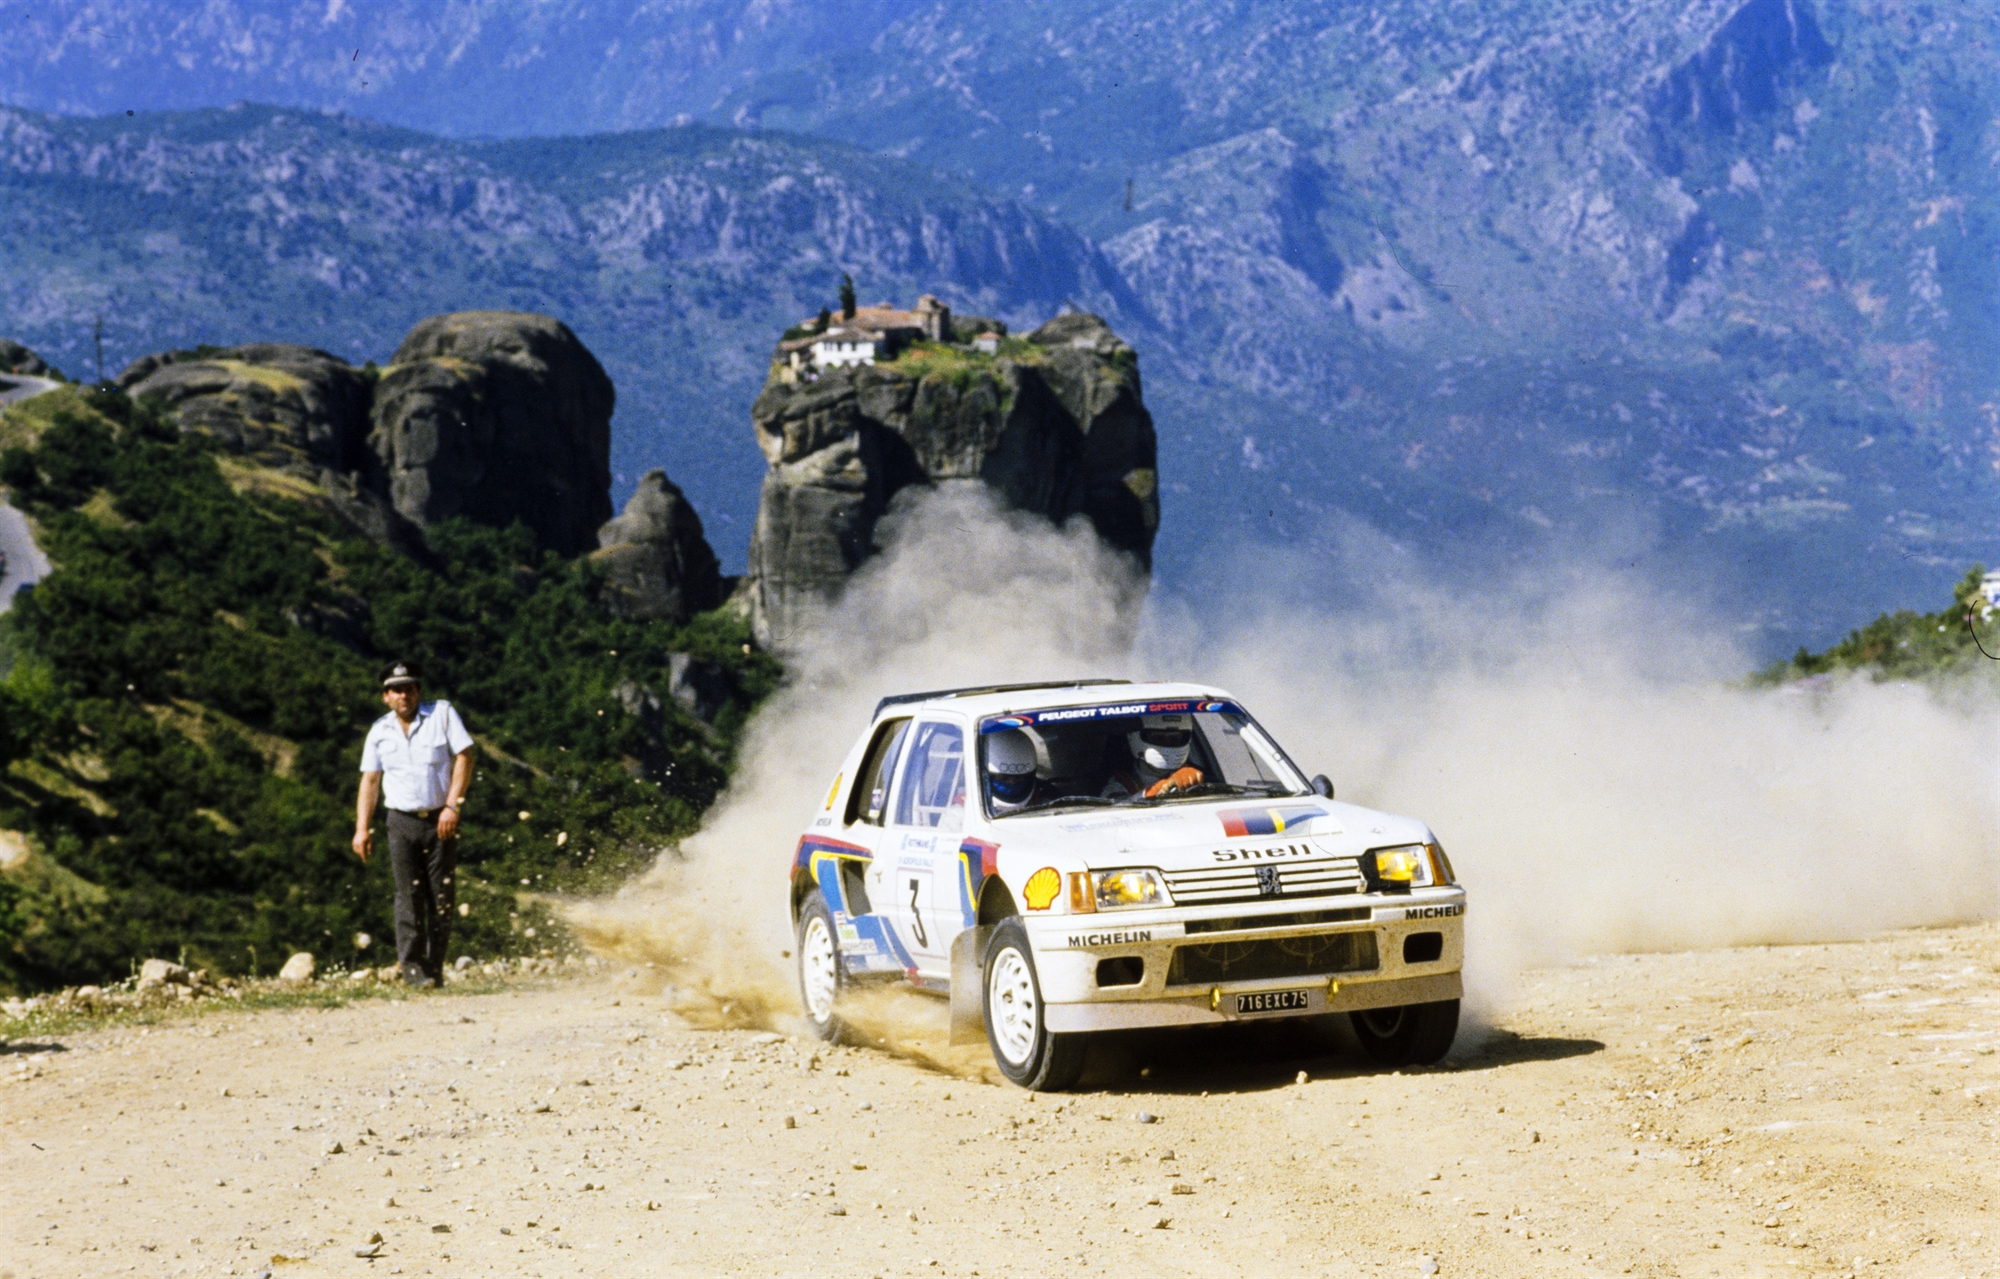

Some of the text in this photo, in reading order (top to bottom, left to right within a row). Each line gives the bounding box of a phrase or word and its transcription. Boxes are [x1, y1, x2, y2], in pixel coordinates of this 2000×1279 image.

[1038, 702, 1189, 722] PEUGEOT TALBOT SPORT
[1212, 844, 1311, 862] Shell
[909, 878, 928, 949] 3
[1068, 931, 1151, 947] MICHELIN
[1239, 991, 1307, 1011] 716 EXC 75
